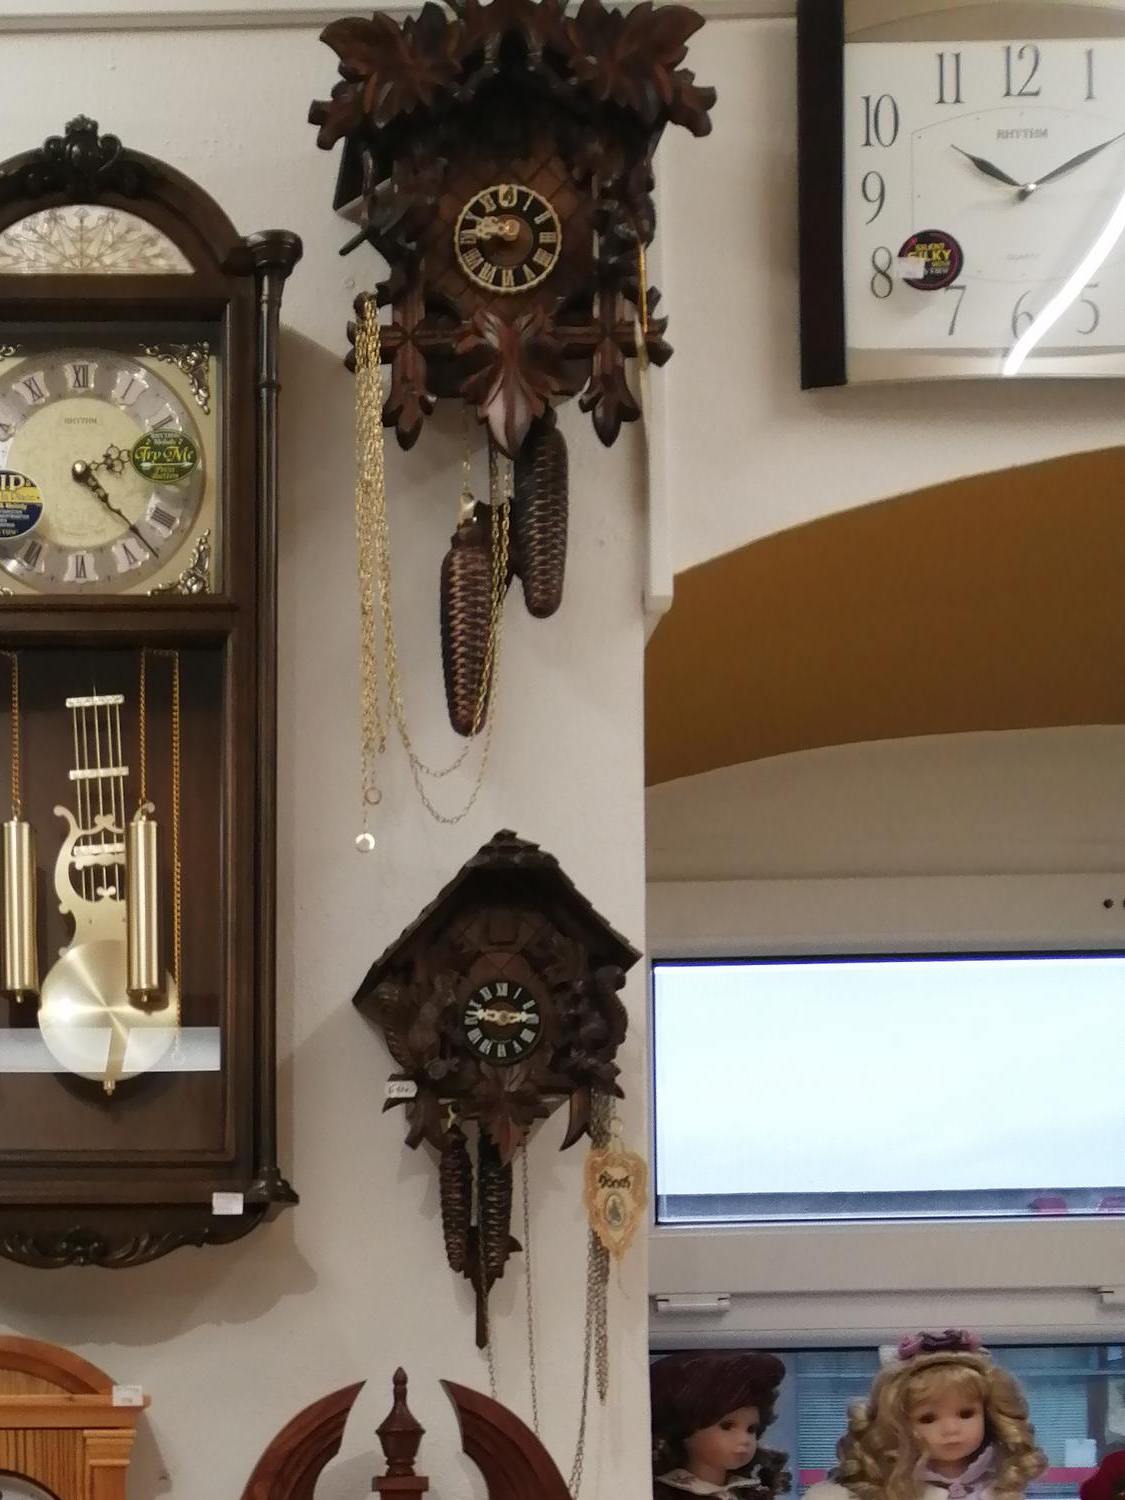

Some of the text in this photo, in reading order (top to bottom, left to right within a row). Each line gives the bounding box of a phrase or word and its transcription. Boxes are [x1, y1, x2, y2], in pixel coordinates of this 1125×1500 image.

[935, 52, 964, 104] 11
[1003, 44, 1041, 96] 12
[1084, 48, 1096, 100] 1
[861, 94, 898, 147] 10
[862, 171, 885, 225] 9
[871, 246, 893, 298] 8
[944, 284, 966, 335] 7
